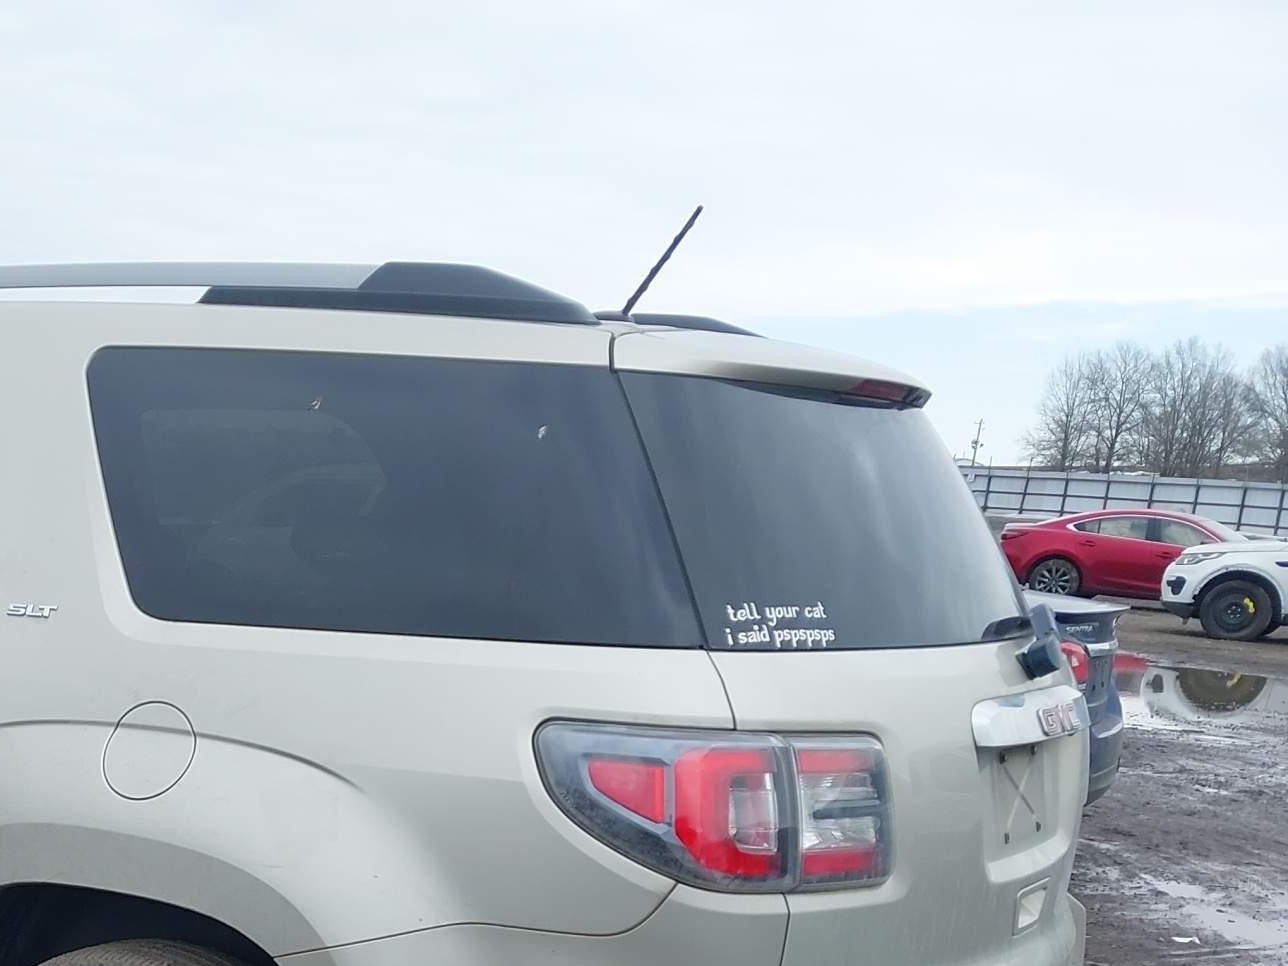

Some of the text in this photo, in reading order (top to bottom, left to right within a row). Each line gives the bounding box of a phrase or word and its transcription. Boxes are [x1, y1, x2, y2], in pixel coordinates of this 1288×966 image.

[7, 603, 58, 619] SLT
[726, 601, 827, 626] tell your cat
[725, 624, 836, 648] i said pspspsps
